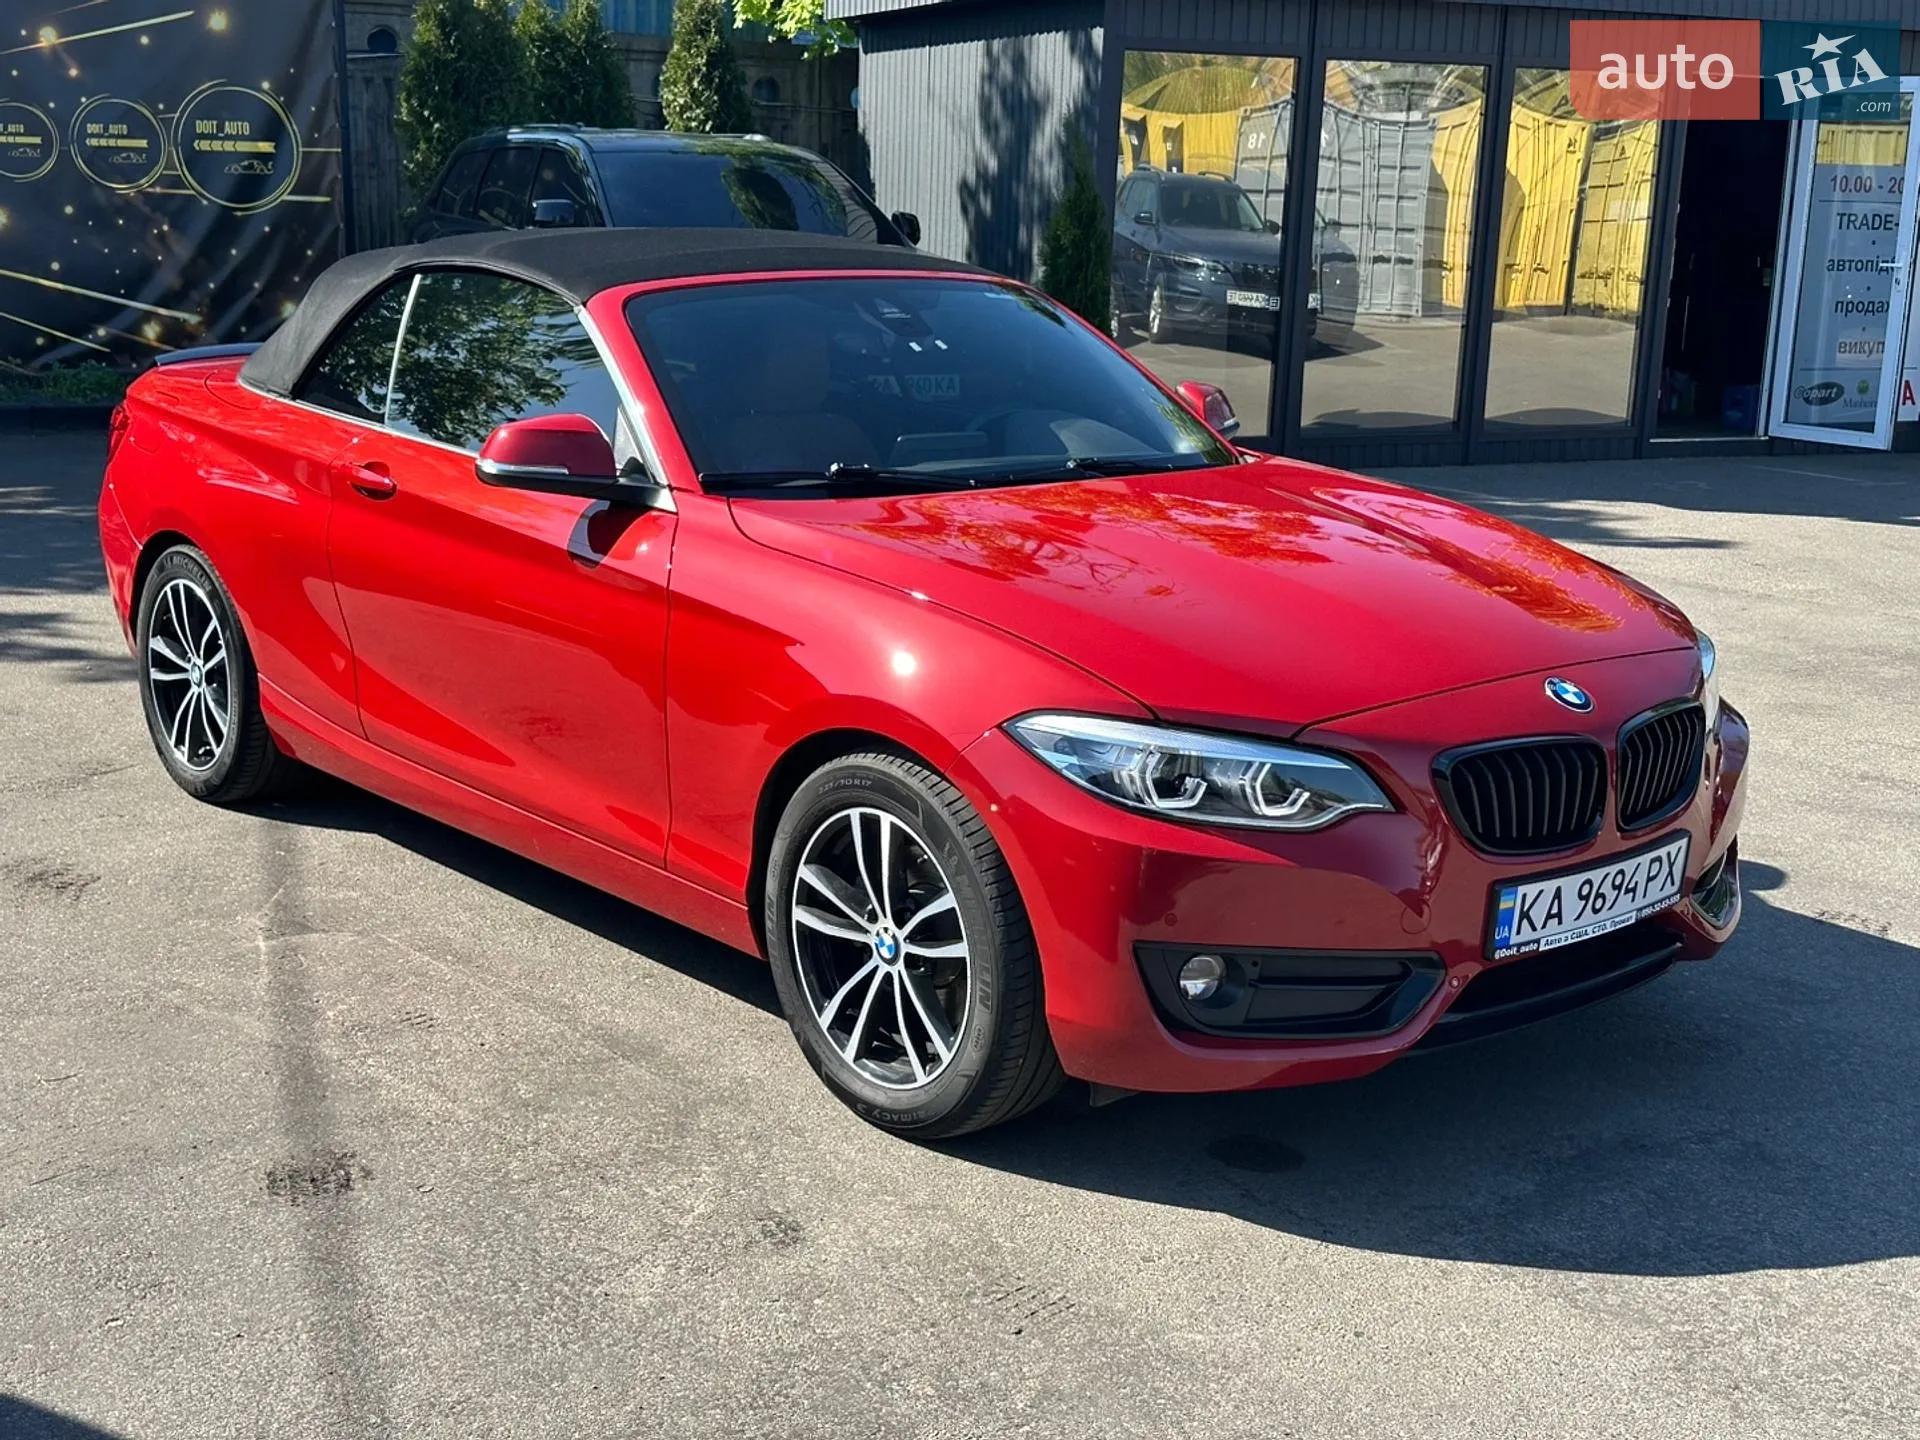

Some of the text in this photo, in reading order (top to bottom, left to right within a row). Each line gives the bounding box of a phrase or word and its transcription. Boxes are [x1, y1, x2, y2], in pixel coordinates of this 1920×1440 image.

[195, 120, 250, 137] DOIT_AUTO
[1830, 174, 1873, 193] 10.00
[1516, 886, 1563, 936] KA
[1574, 862, 1641, 921] 9694
[1643, 846, 1682, 898] PX
[1495, 925, 1510, 940] UA
